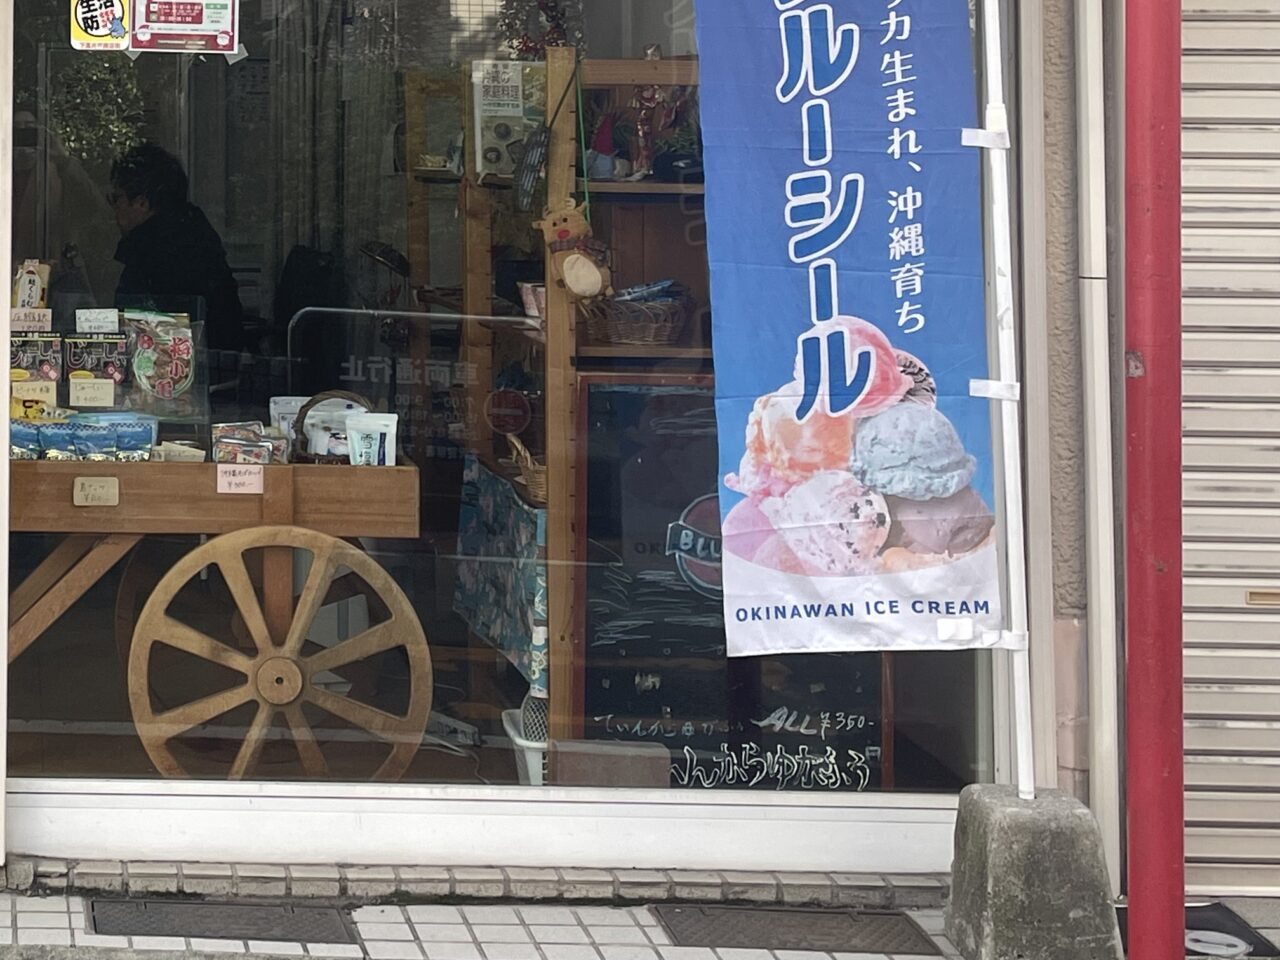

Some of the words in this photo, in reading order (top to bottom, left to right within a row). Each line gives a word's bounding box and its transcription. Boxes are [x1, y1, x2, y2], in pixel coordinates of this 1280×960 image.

[735, 603, 854, 623] OKINAWAN
[864, 600, 901, 616] ICE
[911, 599, 991, 617] CREAM
